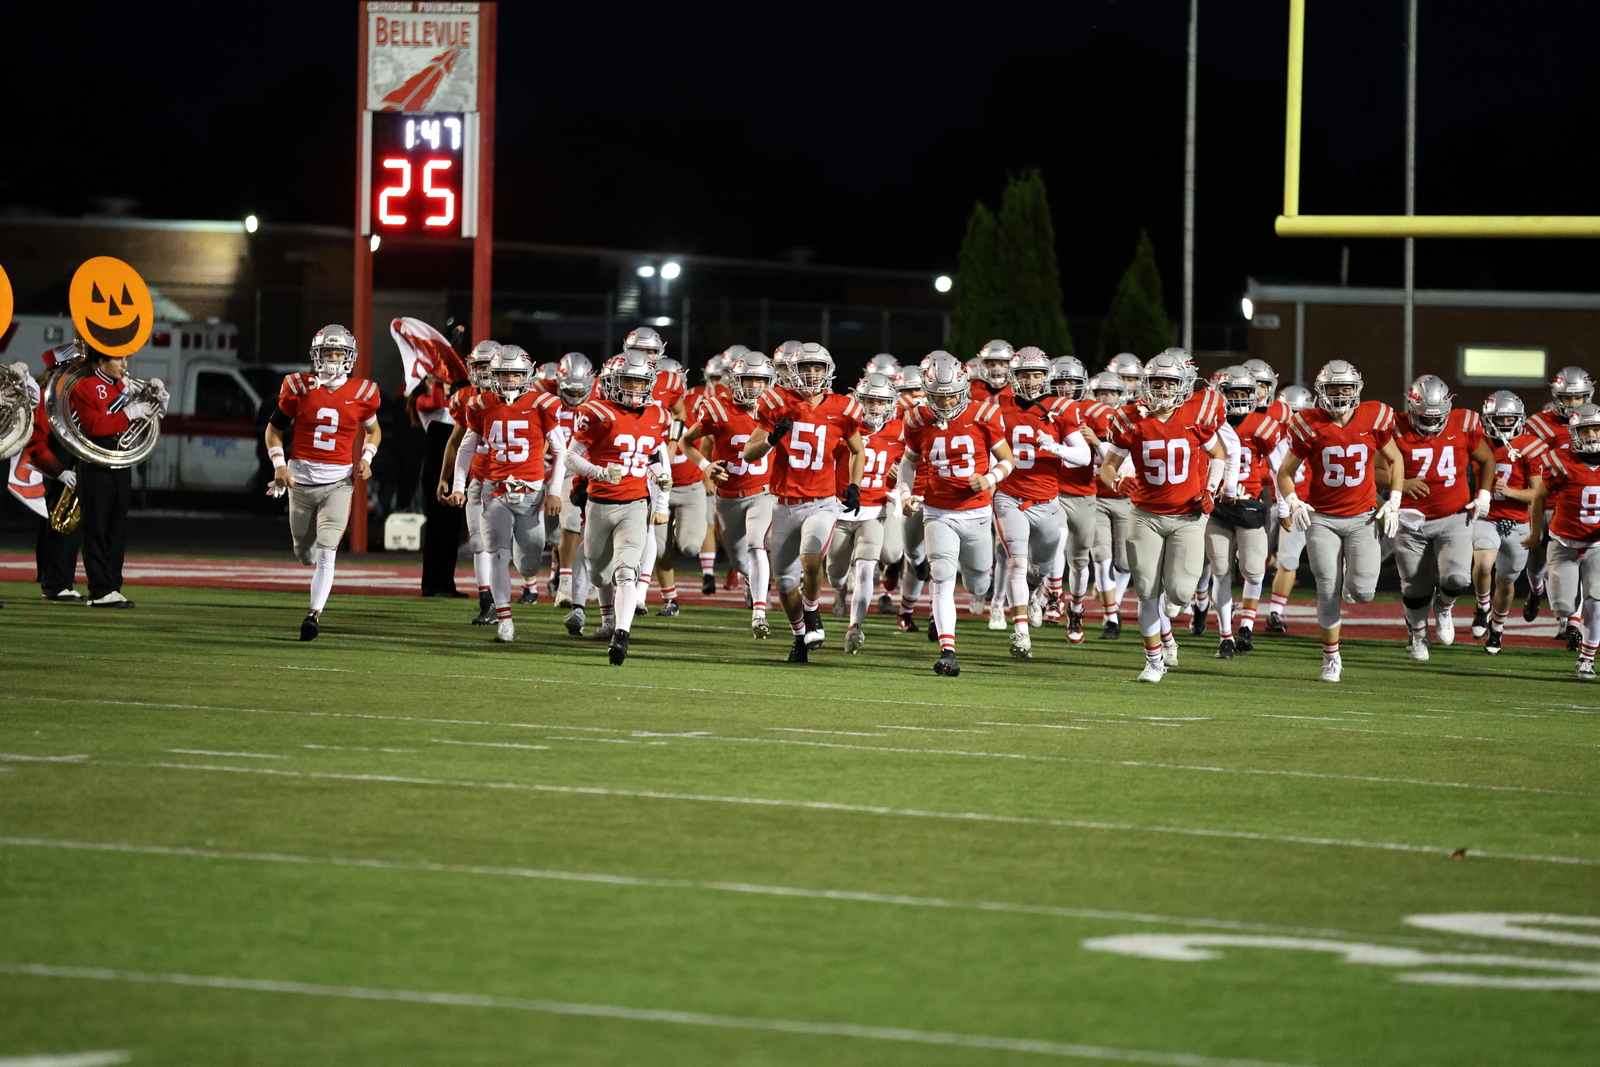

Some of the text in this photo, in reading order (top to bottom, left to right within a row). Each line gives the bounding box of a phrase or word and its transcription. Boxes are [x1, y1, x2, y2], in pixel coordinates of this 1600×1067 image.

[405, 117, 462, 150] 1:47
[379, 158, 456, 226] 25
[95, 384, 108, 400] B
[313, 408, 340, 451] 2
[488, 420, 530, 463] 45
[788, 421, 827, 470] 51
[607, 434, 656, 478] 36
[929, 435, 976, 478] 43
[1142, 438, 1191, 486] 50
[1322, 443, 1369, 488] 63
[1412, 445, 1457, 488] 74
